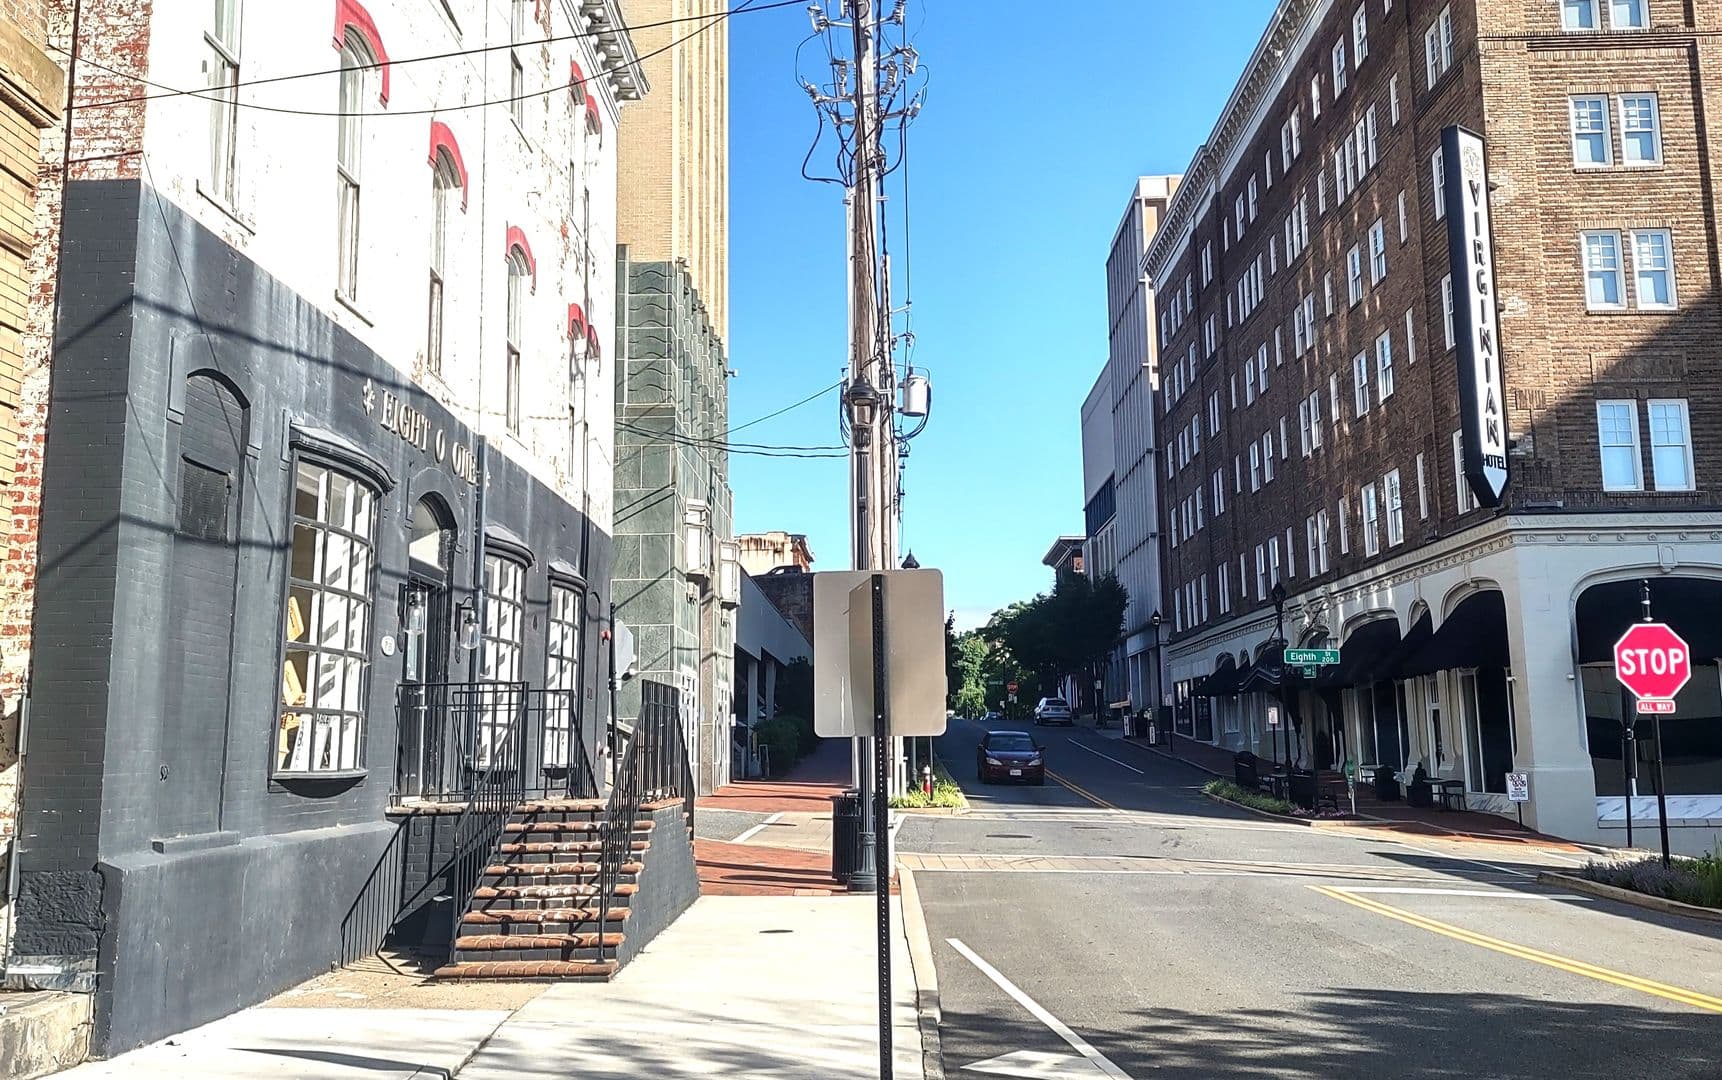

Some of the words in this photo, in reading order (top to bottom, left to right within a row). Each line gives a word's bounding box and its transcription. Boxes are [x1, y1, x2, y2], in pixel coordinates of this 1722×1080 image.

[1468, 179, 1499, 448] VIRGINIAN
[381, 389, 431, 453] EIGHT
[1482, 453, 1507, 470] HOTEL
[1290, 652, 1317, 663] Eighth
[1621, 648, 1684, 675] STOP
[1640, 703, 1654, 711] ALL
[1656, 702, 1672, 711] WAY
